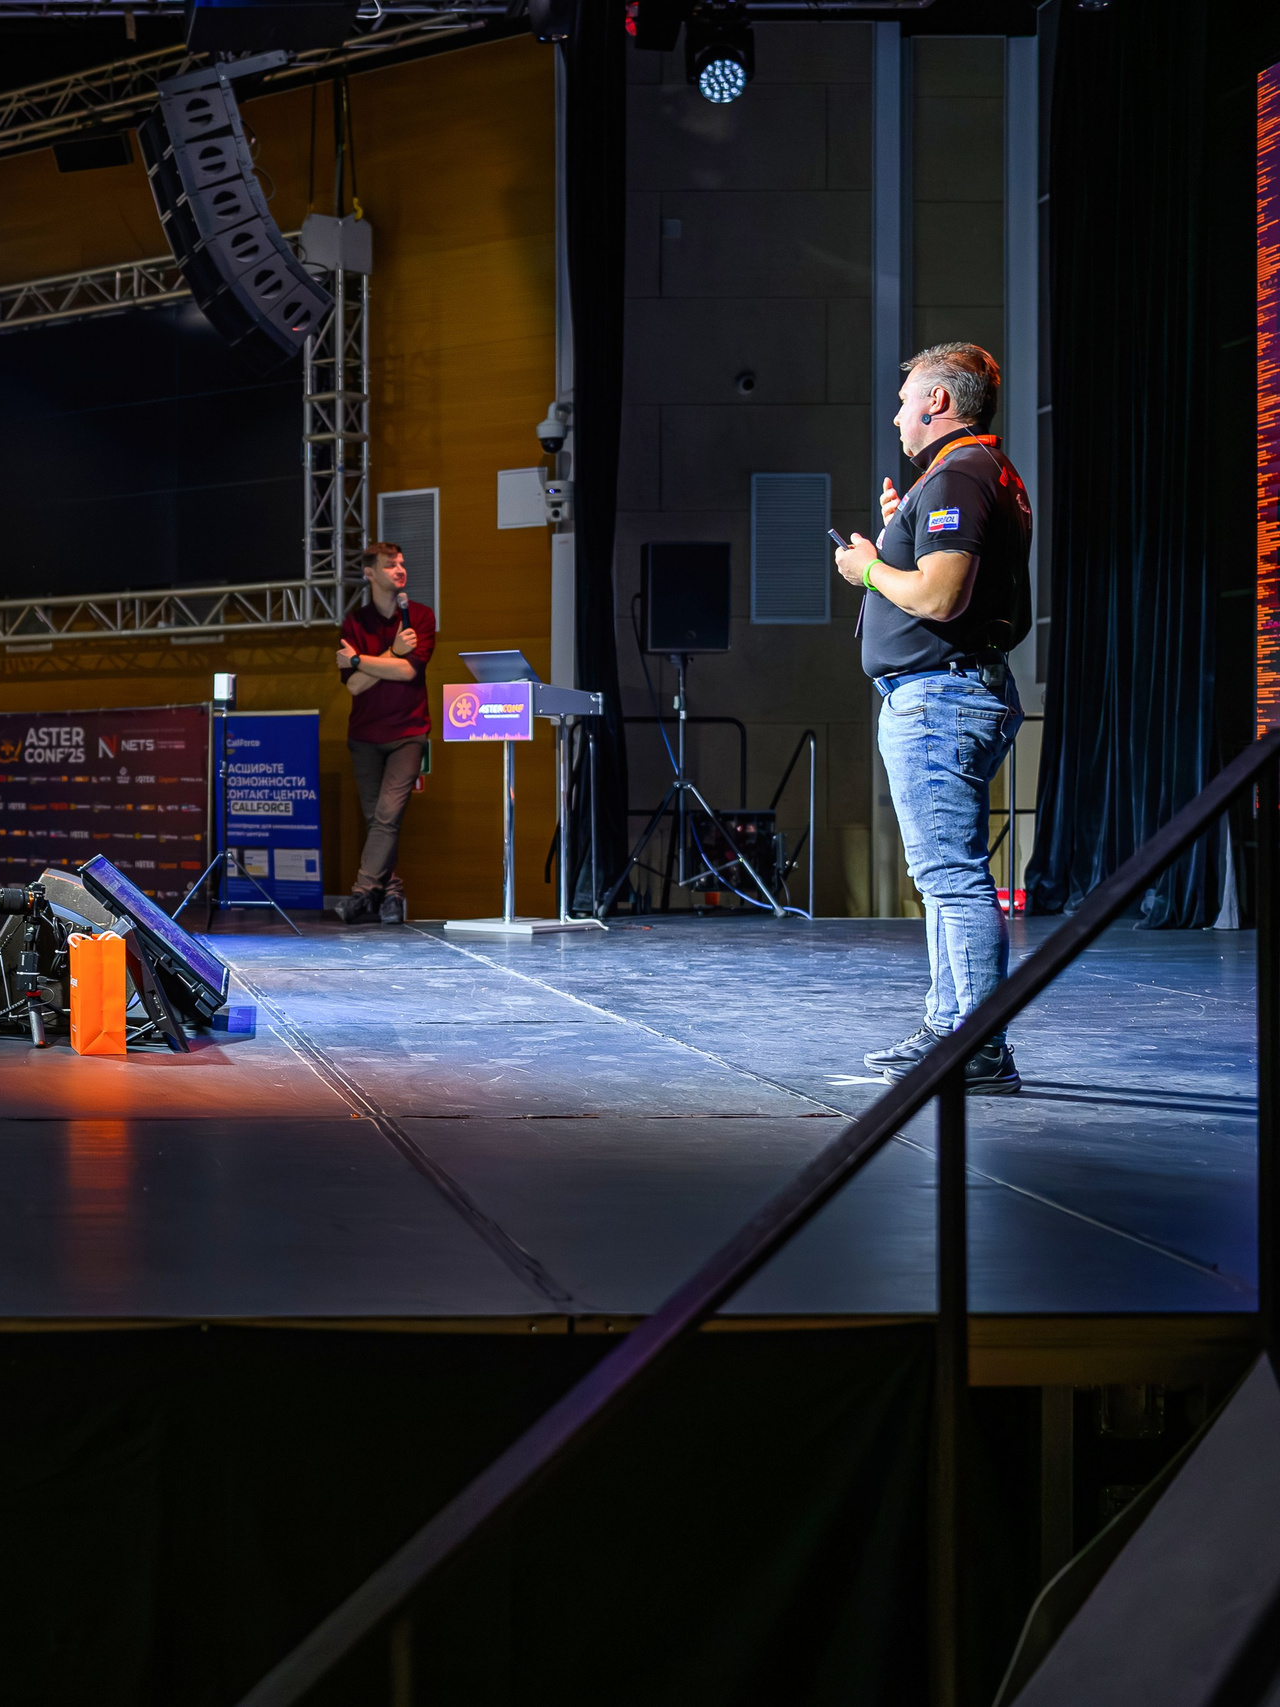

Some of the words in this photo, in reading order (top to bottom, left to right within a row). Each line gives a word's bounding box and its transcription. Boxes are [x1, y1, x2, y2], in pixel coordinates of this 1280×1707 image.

[25, 727, 85, 746] ASTER
[121, 739, 154, 751] NETS
[24, 748, 86, 763] CONF'25
[228, 763, 284, 775] АСШИРЬТЕ
[227, 776, 306, 787] ОЗМОЖНОСТИ
[227, 789, 316, 801] ОНТАКТ-ЦЕНТРА
[232, 802, 290, 813] CALLFORCE
